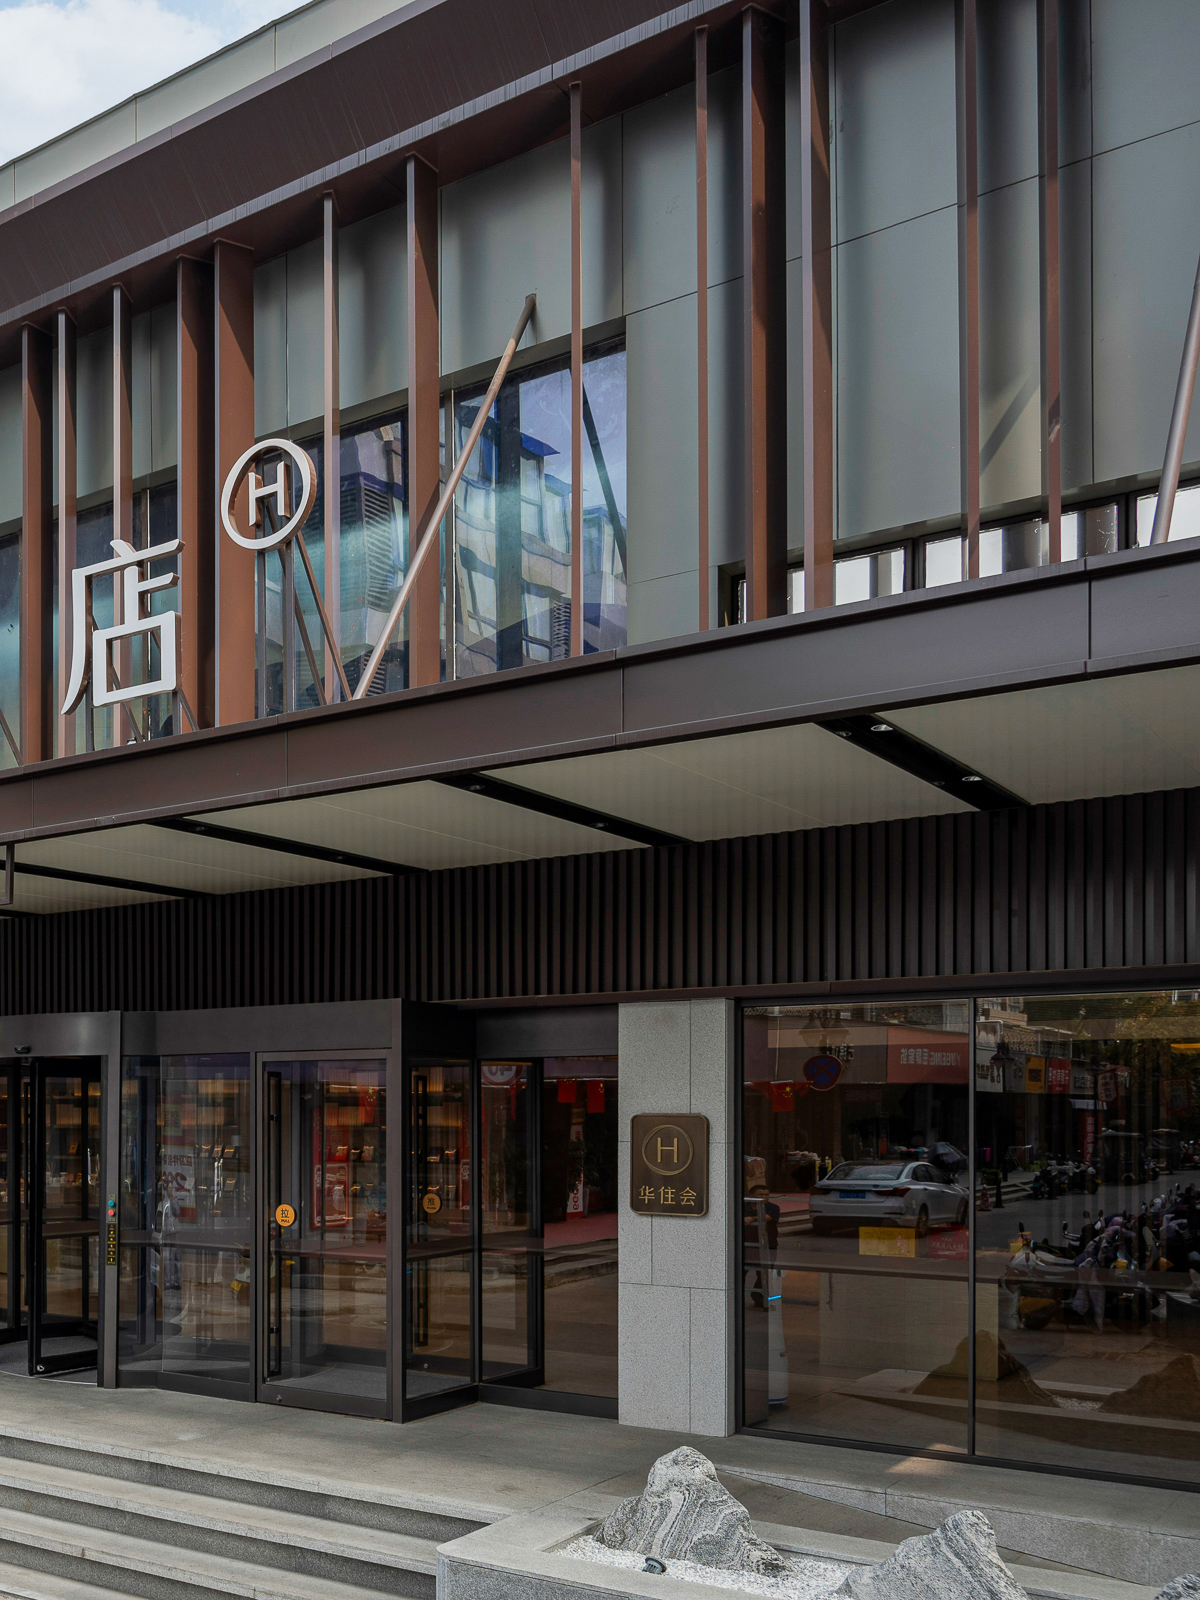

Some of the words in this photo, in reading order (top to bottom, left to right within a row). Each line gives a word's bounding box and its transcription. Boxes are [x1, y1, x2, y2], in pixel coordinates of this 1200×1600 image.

[249, 460, 287, 528] H
[656, 1137, 678, 1163] H
[639, 1185, 697, 1206] 华住会
[280, 1208, 290, 1218] 拉
